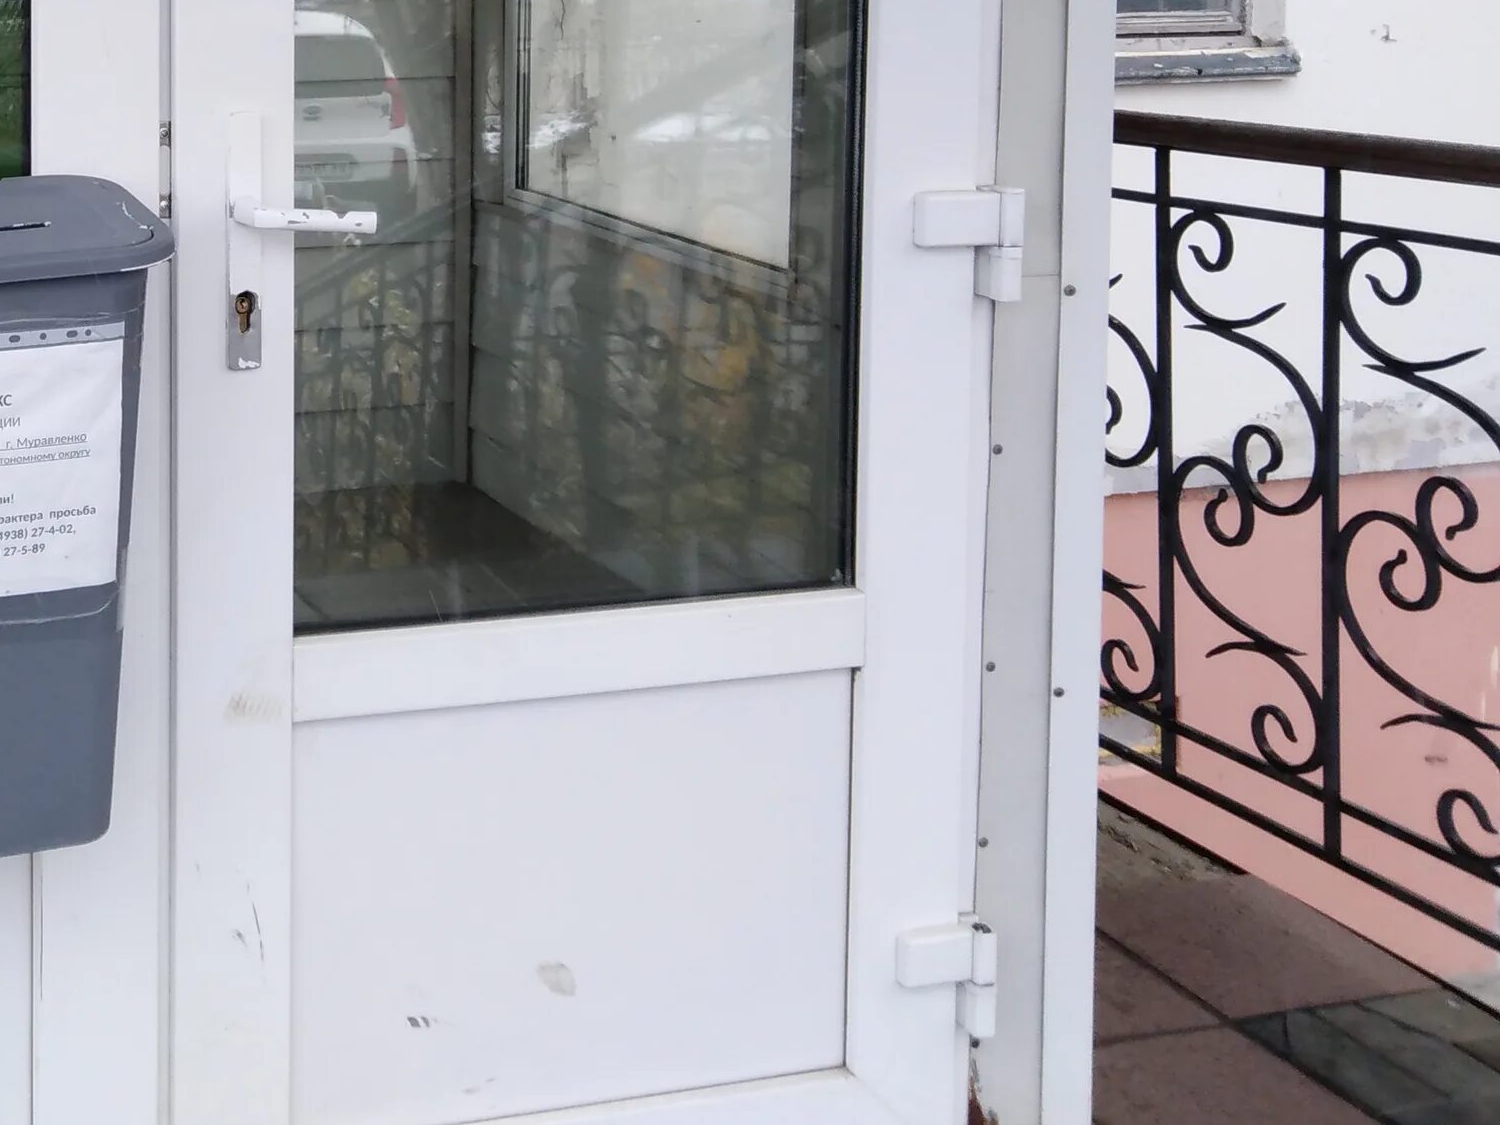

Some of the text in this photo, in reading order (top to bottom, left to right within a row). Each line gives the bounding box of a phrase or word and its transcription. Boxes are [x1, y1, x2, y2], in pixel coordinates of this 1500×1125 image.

[6, 439, 14, 451] г.
[16, 432, 88, 449] Муравленко
[58, 446, 91, 461] округу
[49, 505, 96, 522] просьба
[32, 523, 76, 538] 27-4-02,
[4, 542, 45, 557] 27-5-89
